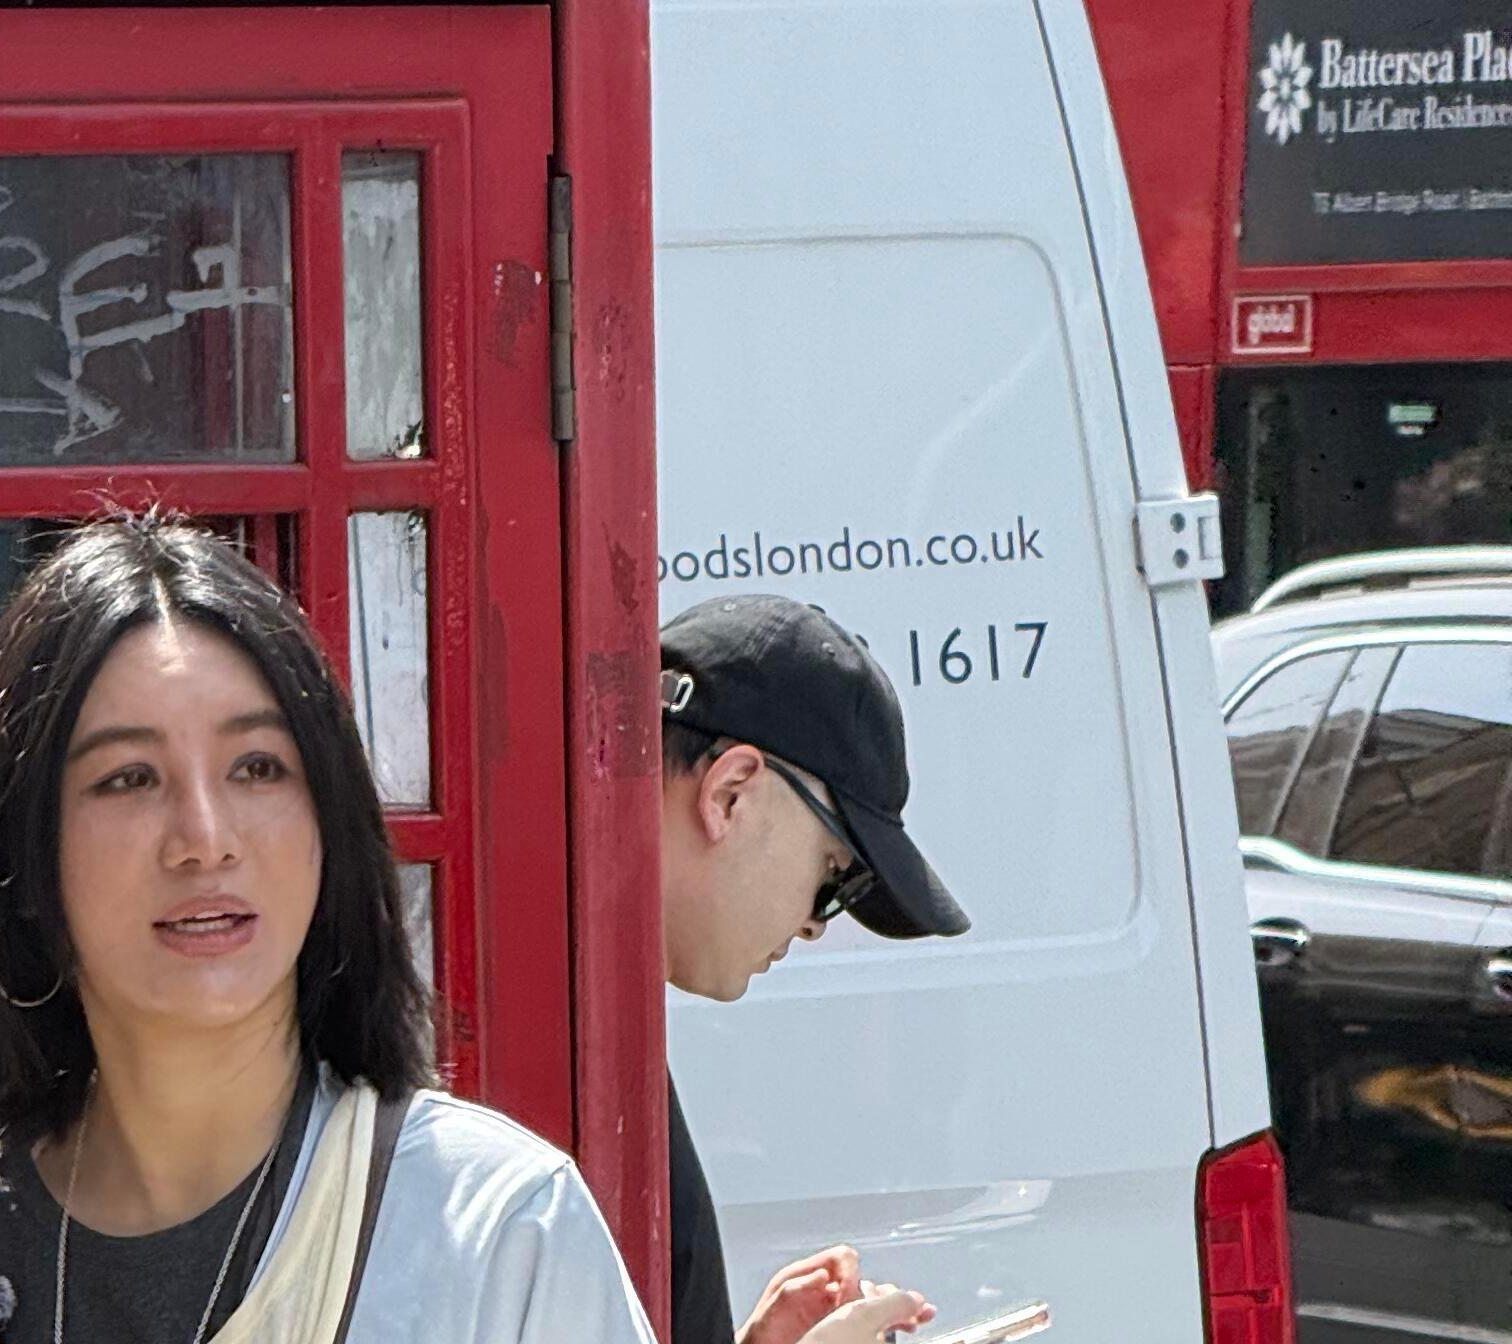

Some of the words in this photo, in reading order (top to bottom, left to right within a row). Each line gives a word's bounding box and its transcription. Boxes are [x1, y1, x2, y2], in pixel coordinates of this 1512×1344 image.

[1318, 38, 1455, 88] Battersea
[1317, 99, 1338, 143] by
[909, 620, 1048, 686] 1617
